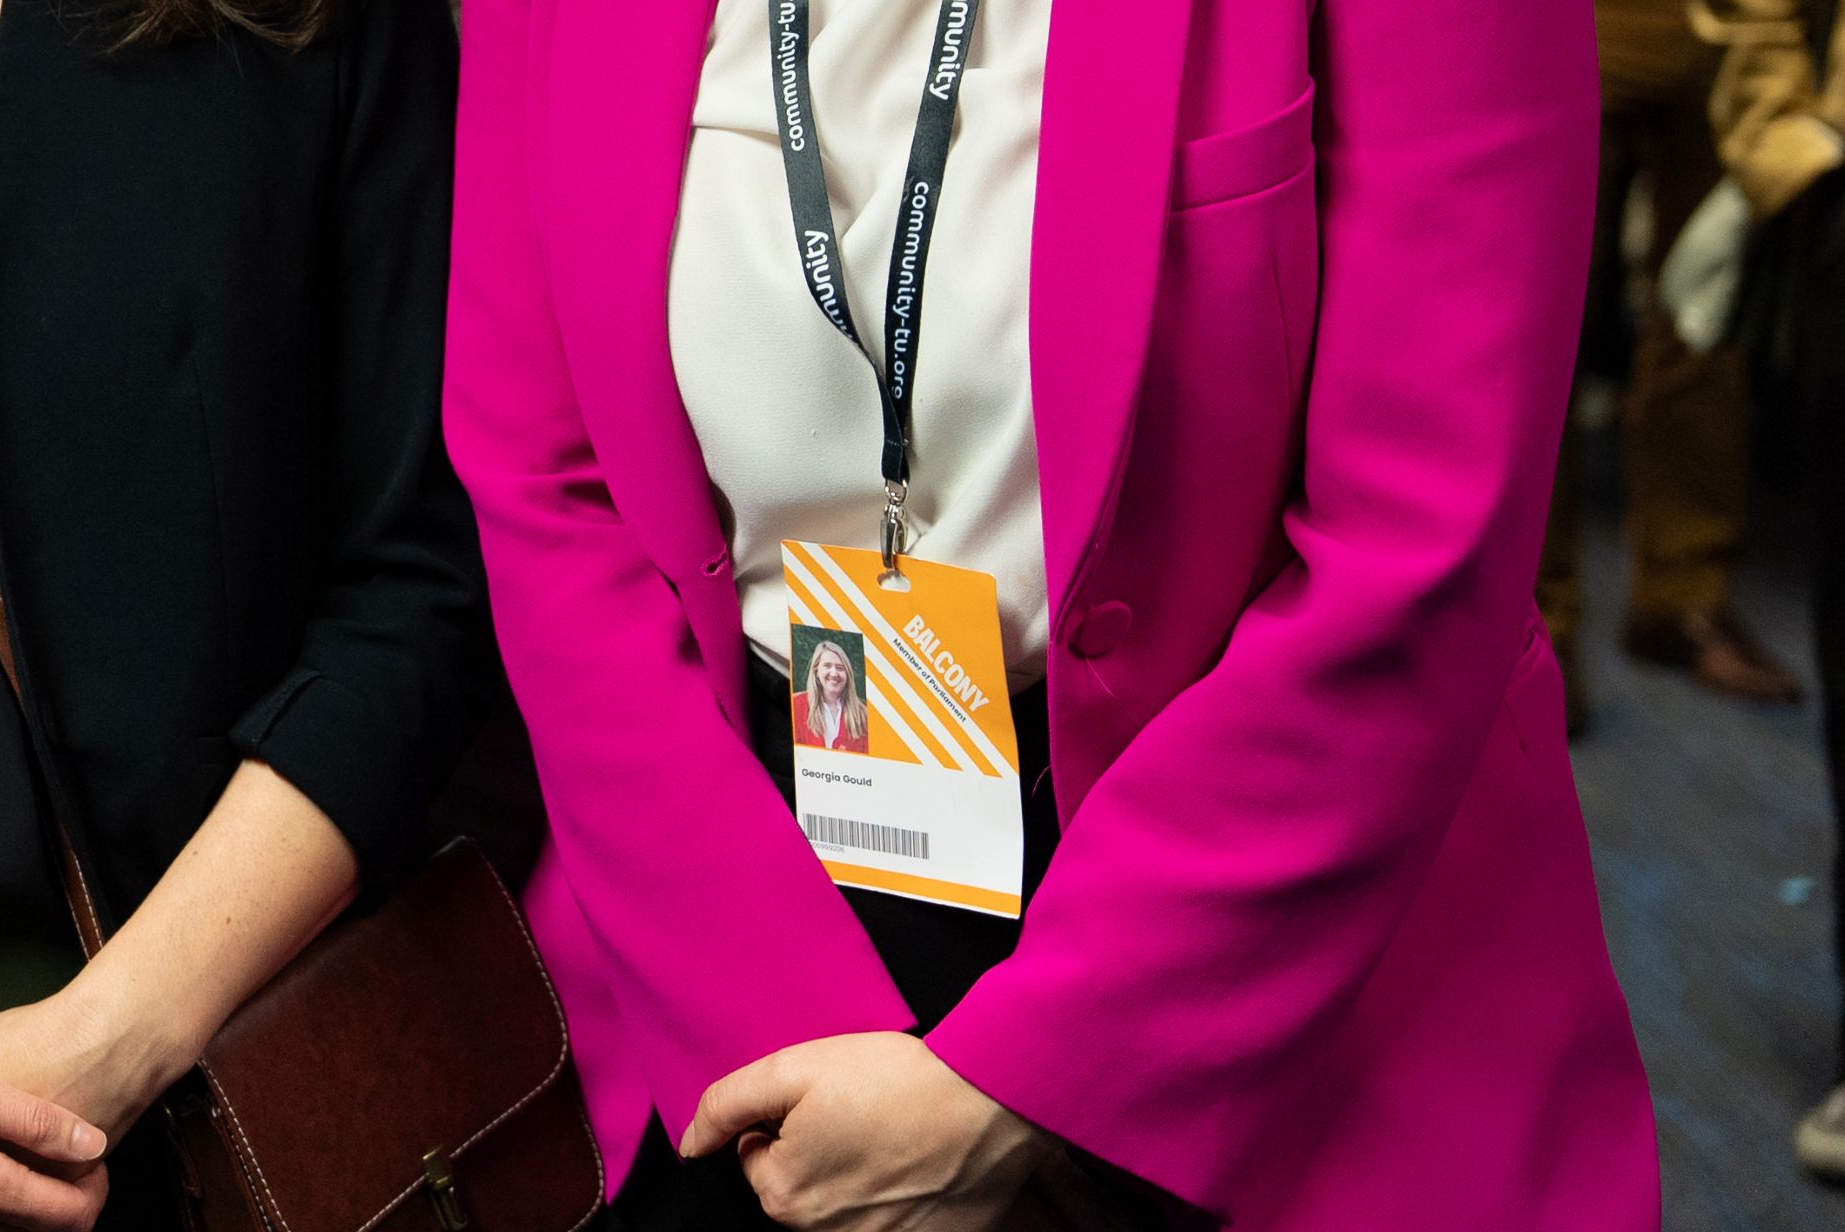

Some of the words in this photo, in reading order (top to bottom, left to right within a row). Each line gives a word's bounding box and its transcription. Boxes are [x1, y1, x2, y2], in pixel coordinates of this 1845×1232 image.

[893, 638, 923, 671] Member
[921, 670, 931, 680] of
[929, 678, 967, 723] Parliament
[903, 614, 990, 713] BALCONY
[801, 768, 841, 783] Georgia
[842, 774, 873, 787] Gould
